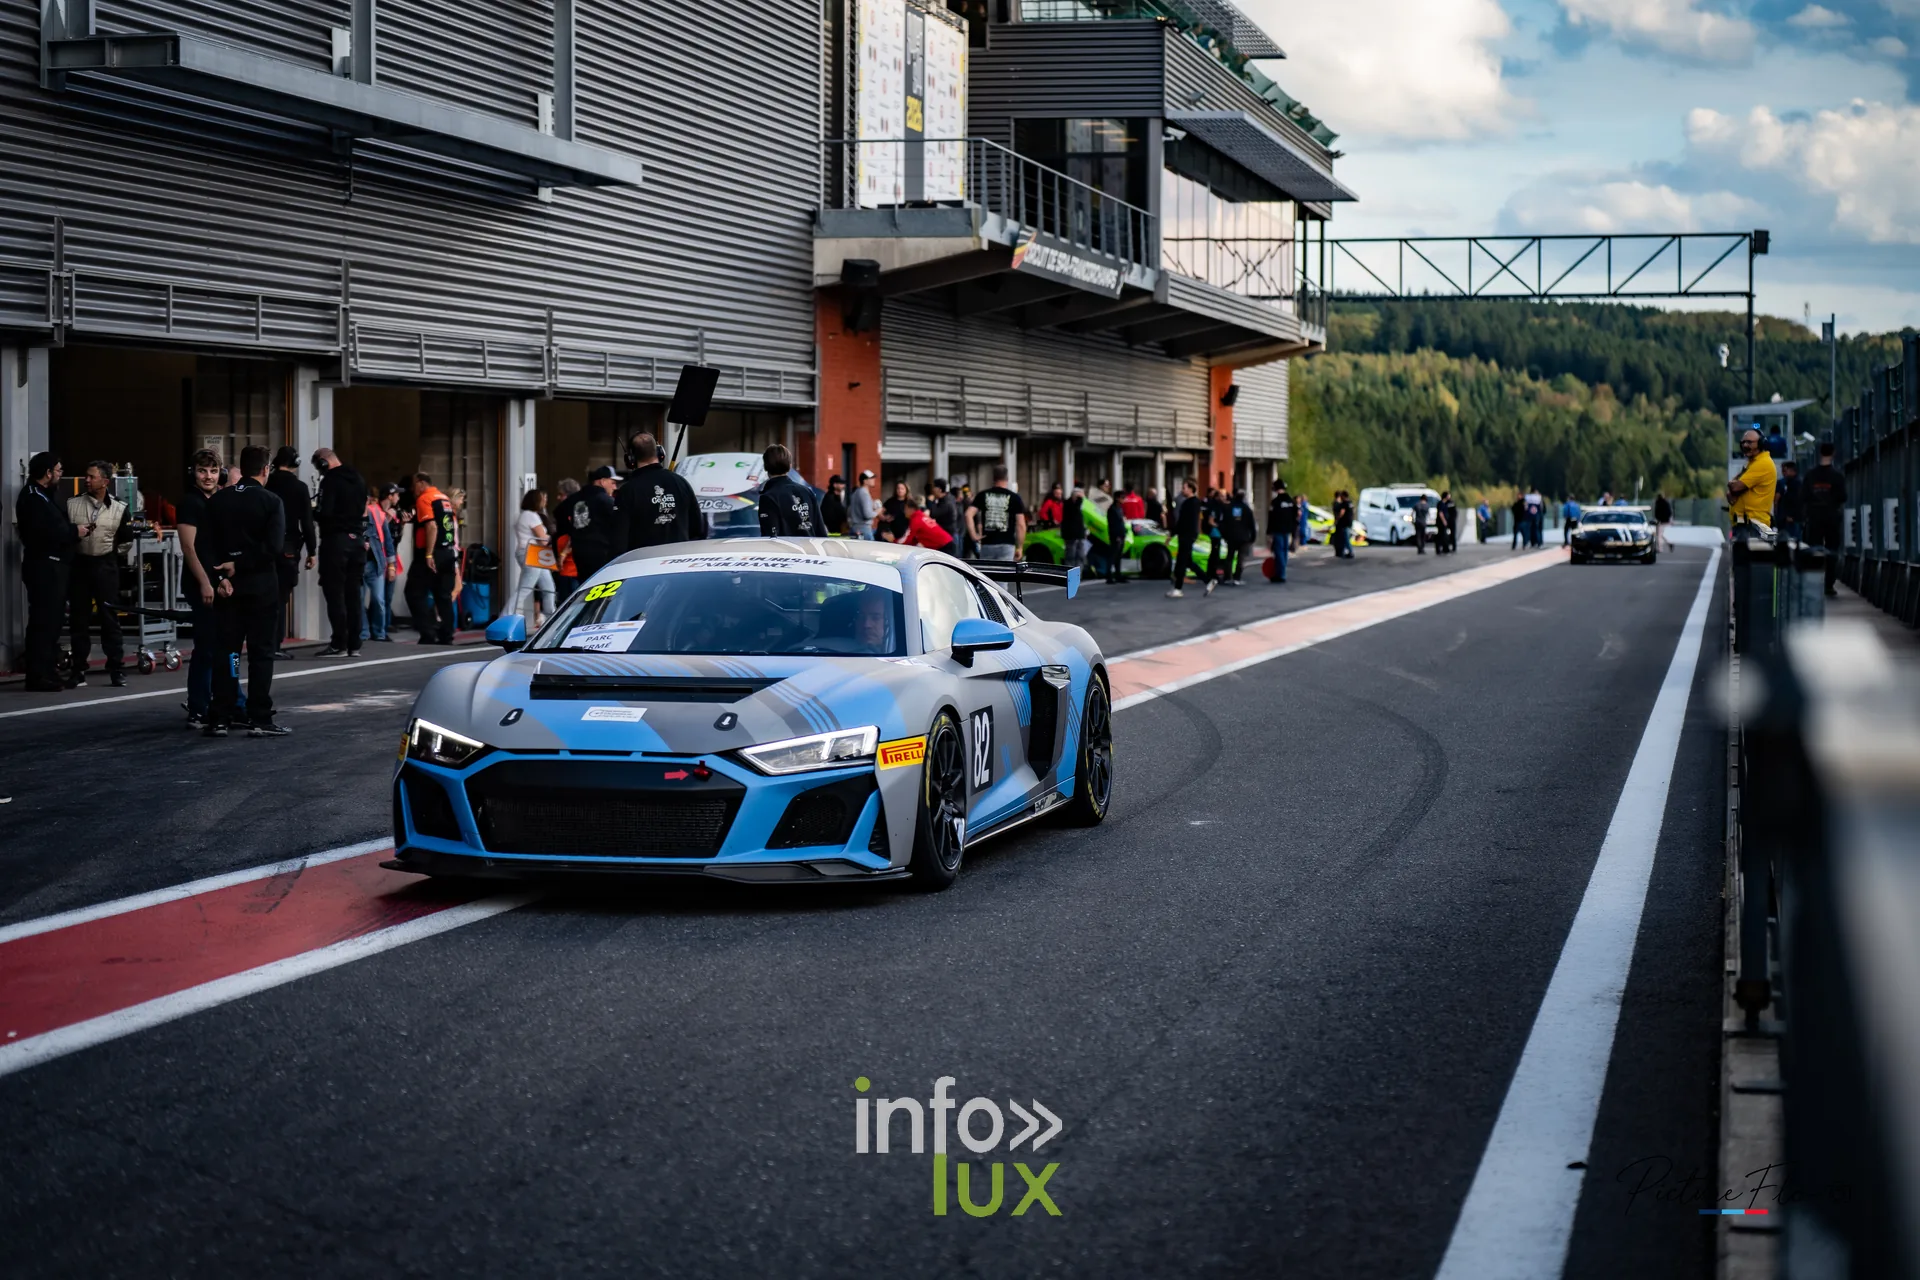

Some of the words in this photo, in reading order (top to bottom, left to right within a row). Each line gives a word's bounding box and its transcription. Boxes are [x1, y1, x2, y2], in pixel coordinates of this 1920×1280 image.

[584, 580, 622, 602] 82
[583, 641, 612, 650] ERMÉ
[585, 634, 614, 642] PARC
[881, 741, 925, 764] PIRELLI
[973, 711, 990, 789] 82
